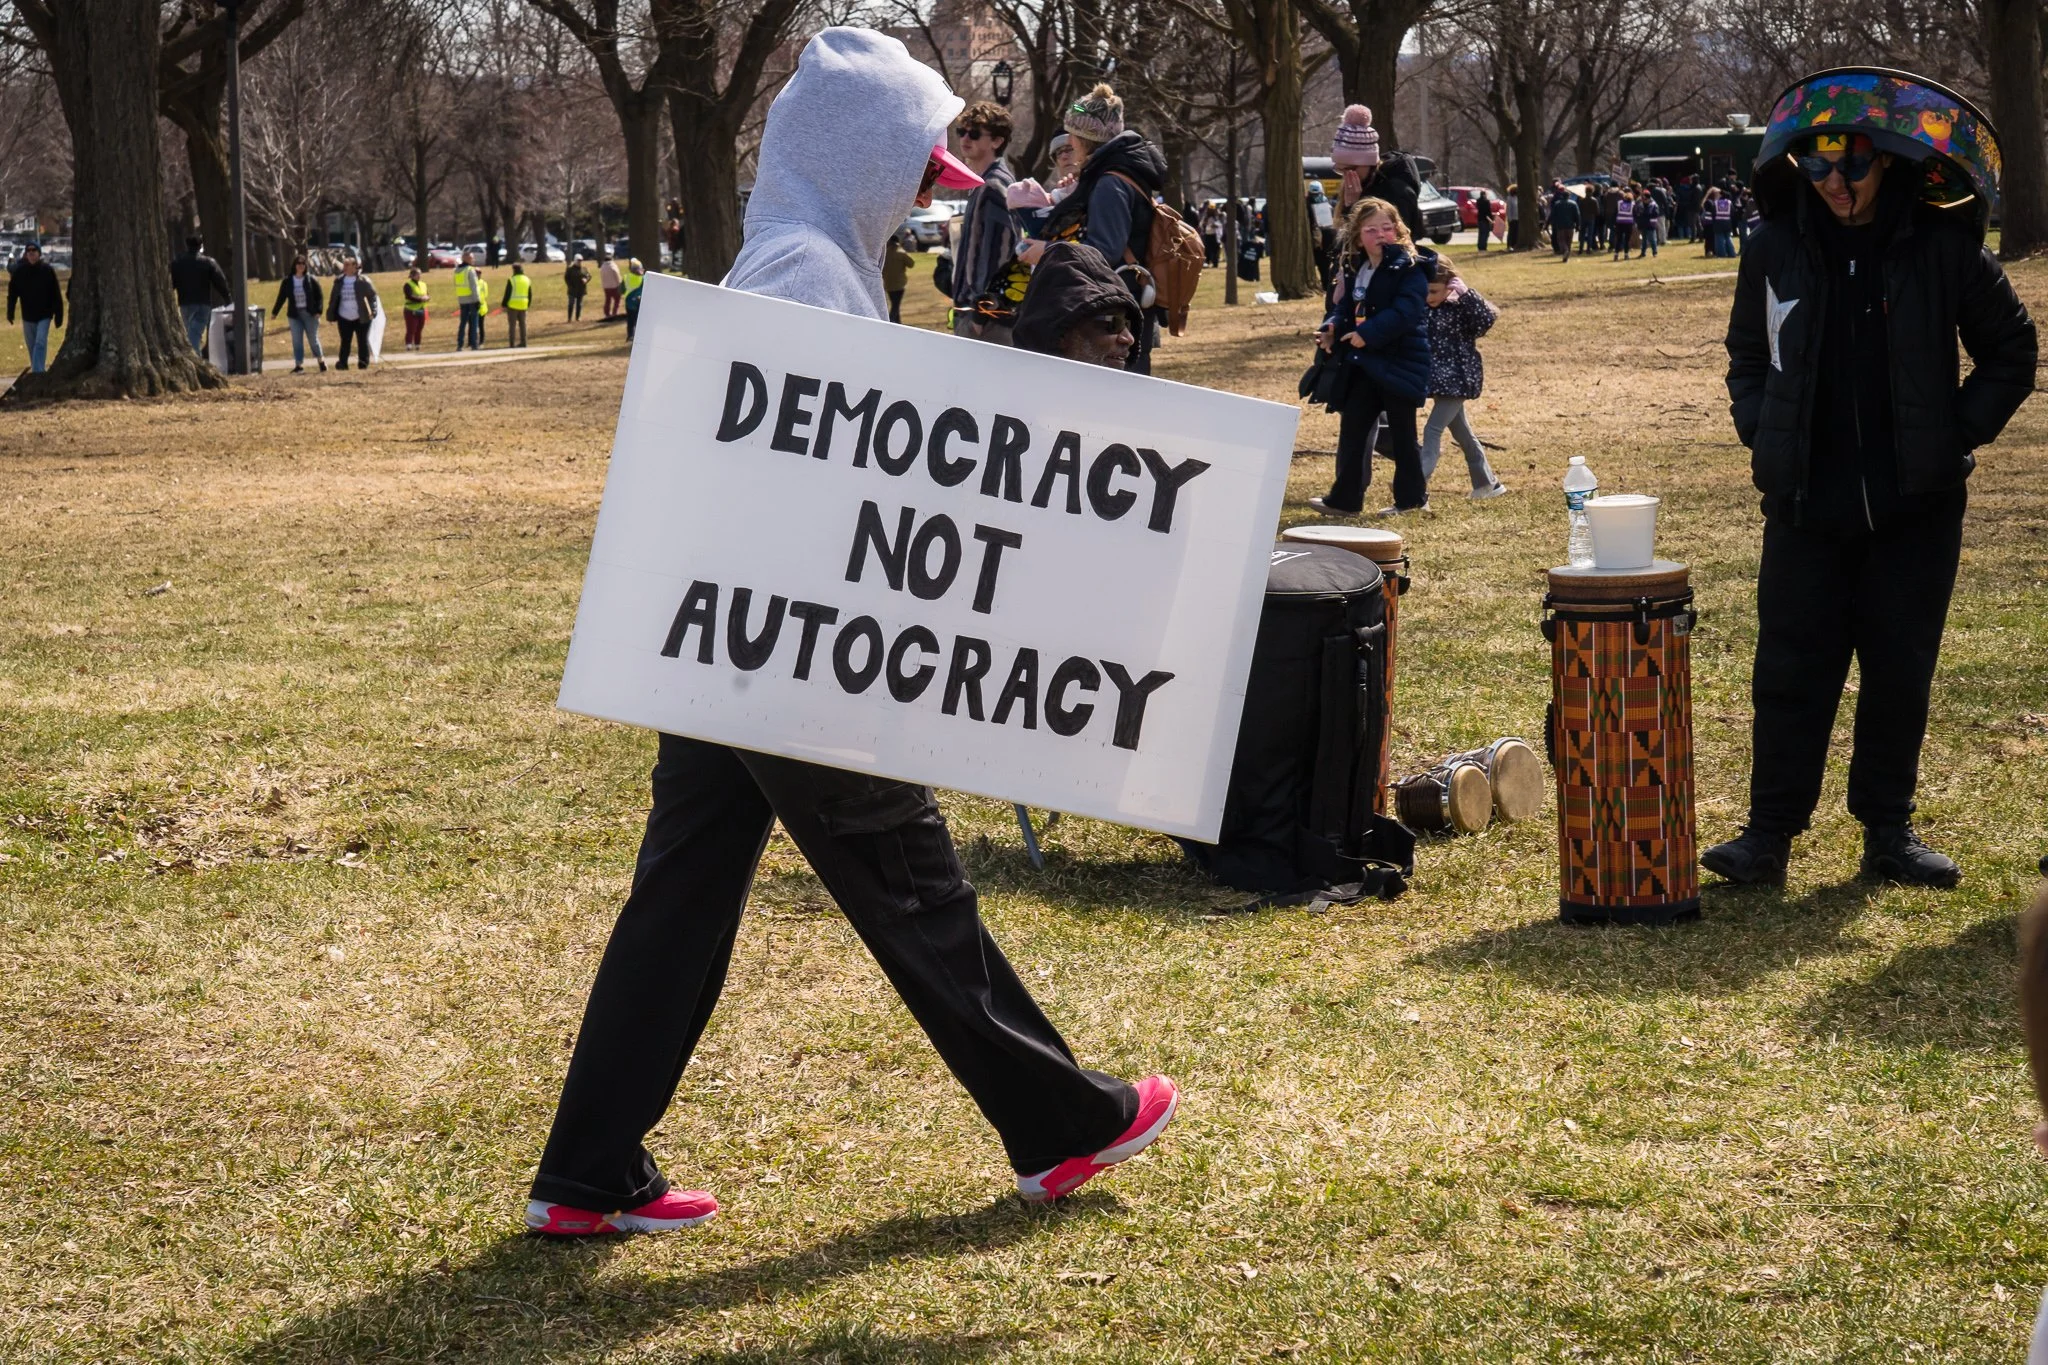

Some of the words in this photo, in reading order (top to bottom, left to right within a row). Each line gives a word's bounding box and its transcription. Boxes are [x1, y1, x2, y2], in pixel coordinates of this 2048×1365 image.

[715, 360, 1212, 535] DEMOCRACY
[844, 499, 1023, 615] NOT
[660, 579, 1176, 752] AUTOCRACY
